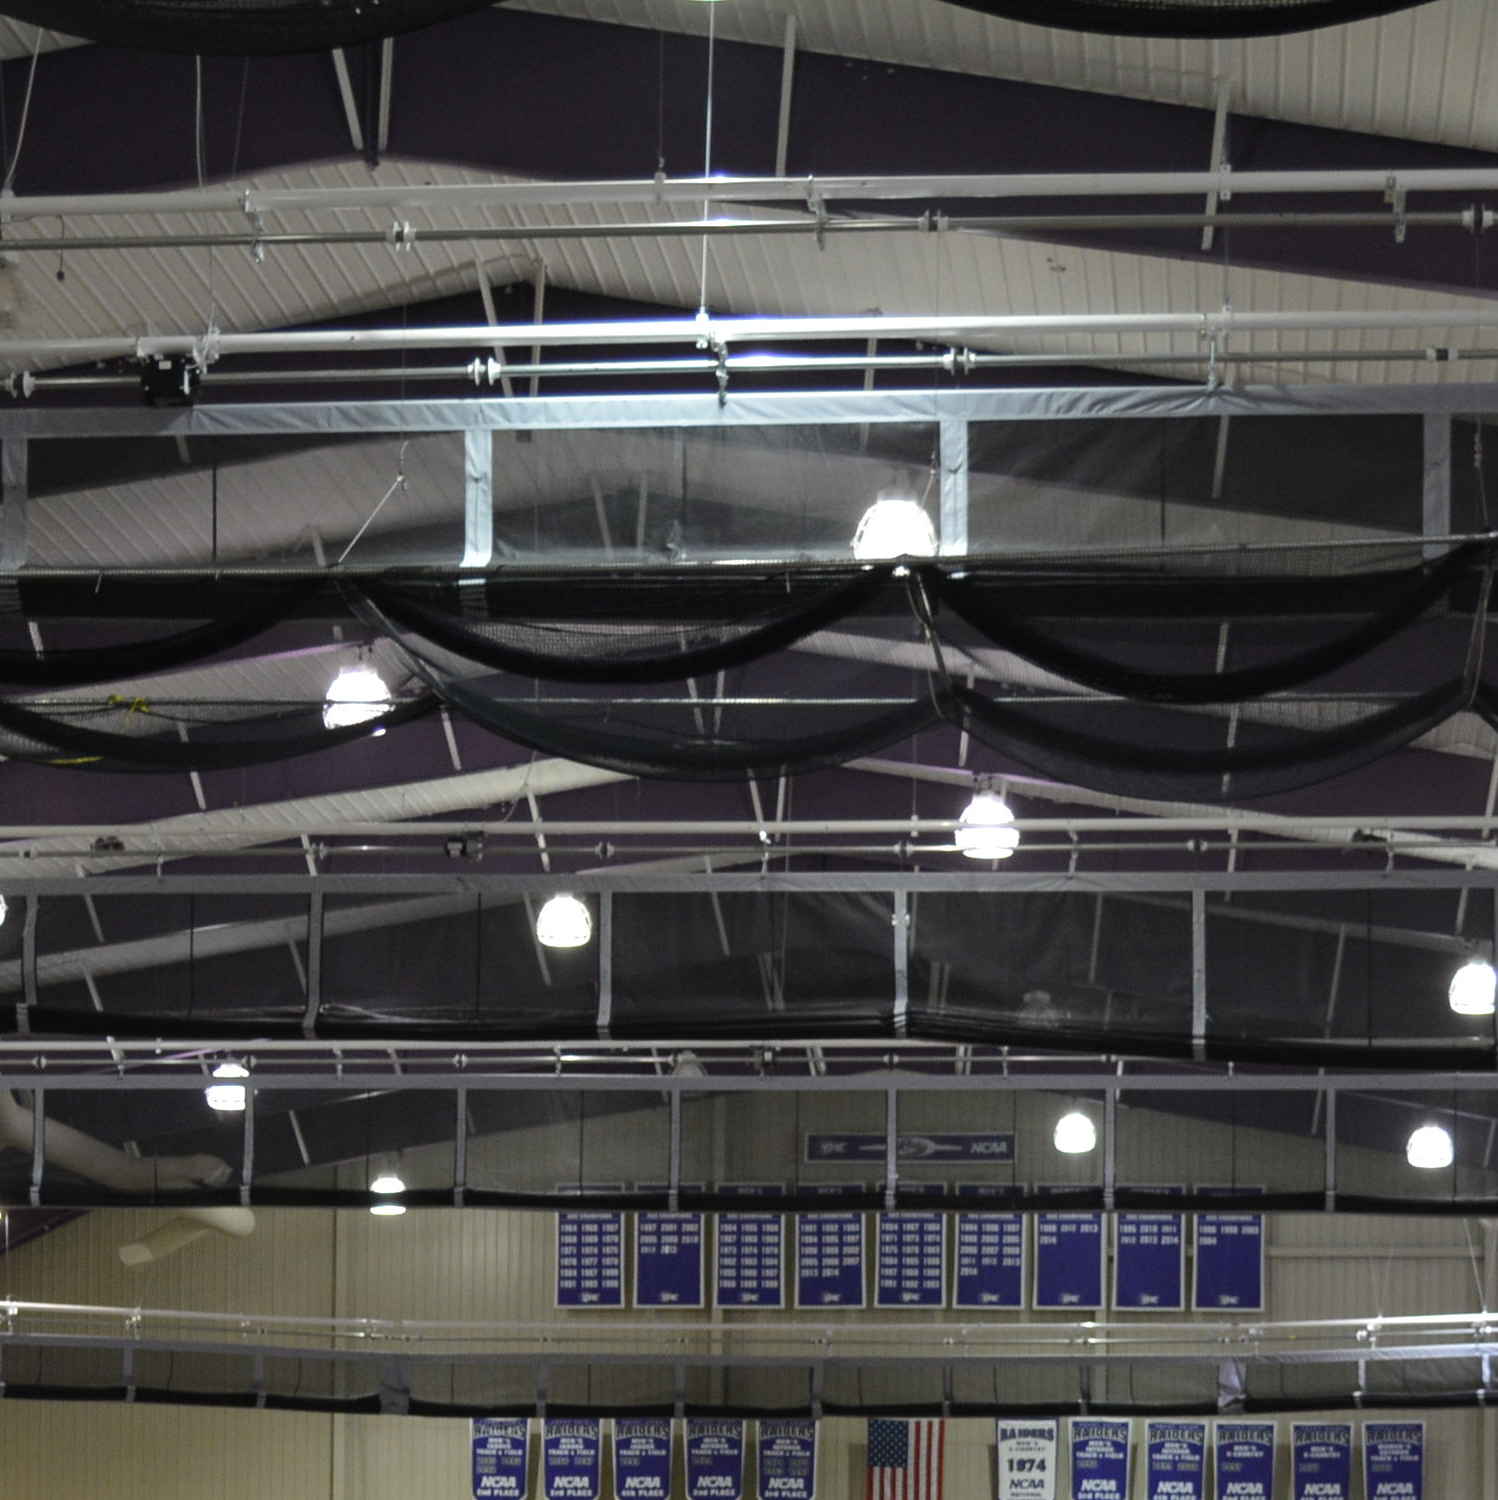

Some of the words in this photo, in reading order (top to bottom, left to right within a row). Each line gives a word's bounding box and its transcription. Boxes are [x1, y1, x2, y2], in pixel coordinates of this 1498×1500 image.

[970, 1142, 1007, 1153] NCAA
[581, 1257, 598, 1266] 1977
[1000, 1428, 1054, 1442] RAIDERS
[1073, 1427, 1127, 1443] RAIDERS
[1150, 1429, 1204, 1445] RAIDERS
[1296, 1430, 1349, 1446] RAIDERS
[1007, 1459, 1046, 1472] 1974
[481, 1476, 516, 1488] NCAA
[553, 1476, 589, 1488] NCAA
[625, 1477, 660, 1488] NCAA
[697, 1476, 732, 1488] NCAA
[768, 1477, 804, 1489] NCAA
[1009, 1480, 1045, 1489] NCAA
[1081, 1479, 1117, 1491] NCAA
[1157, 1481, 1193, 1493] NCAA
[1226, 1482, 1263, 1494] NCAA
[1304, 1483, 1340, 1495] NCAA
[1377, 1483, 1413, 1494] NCAA
